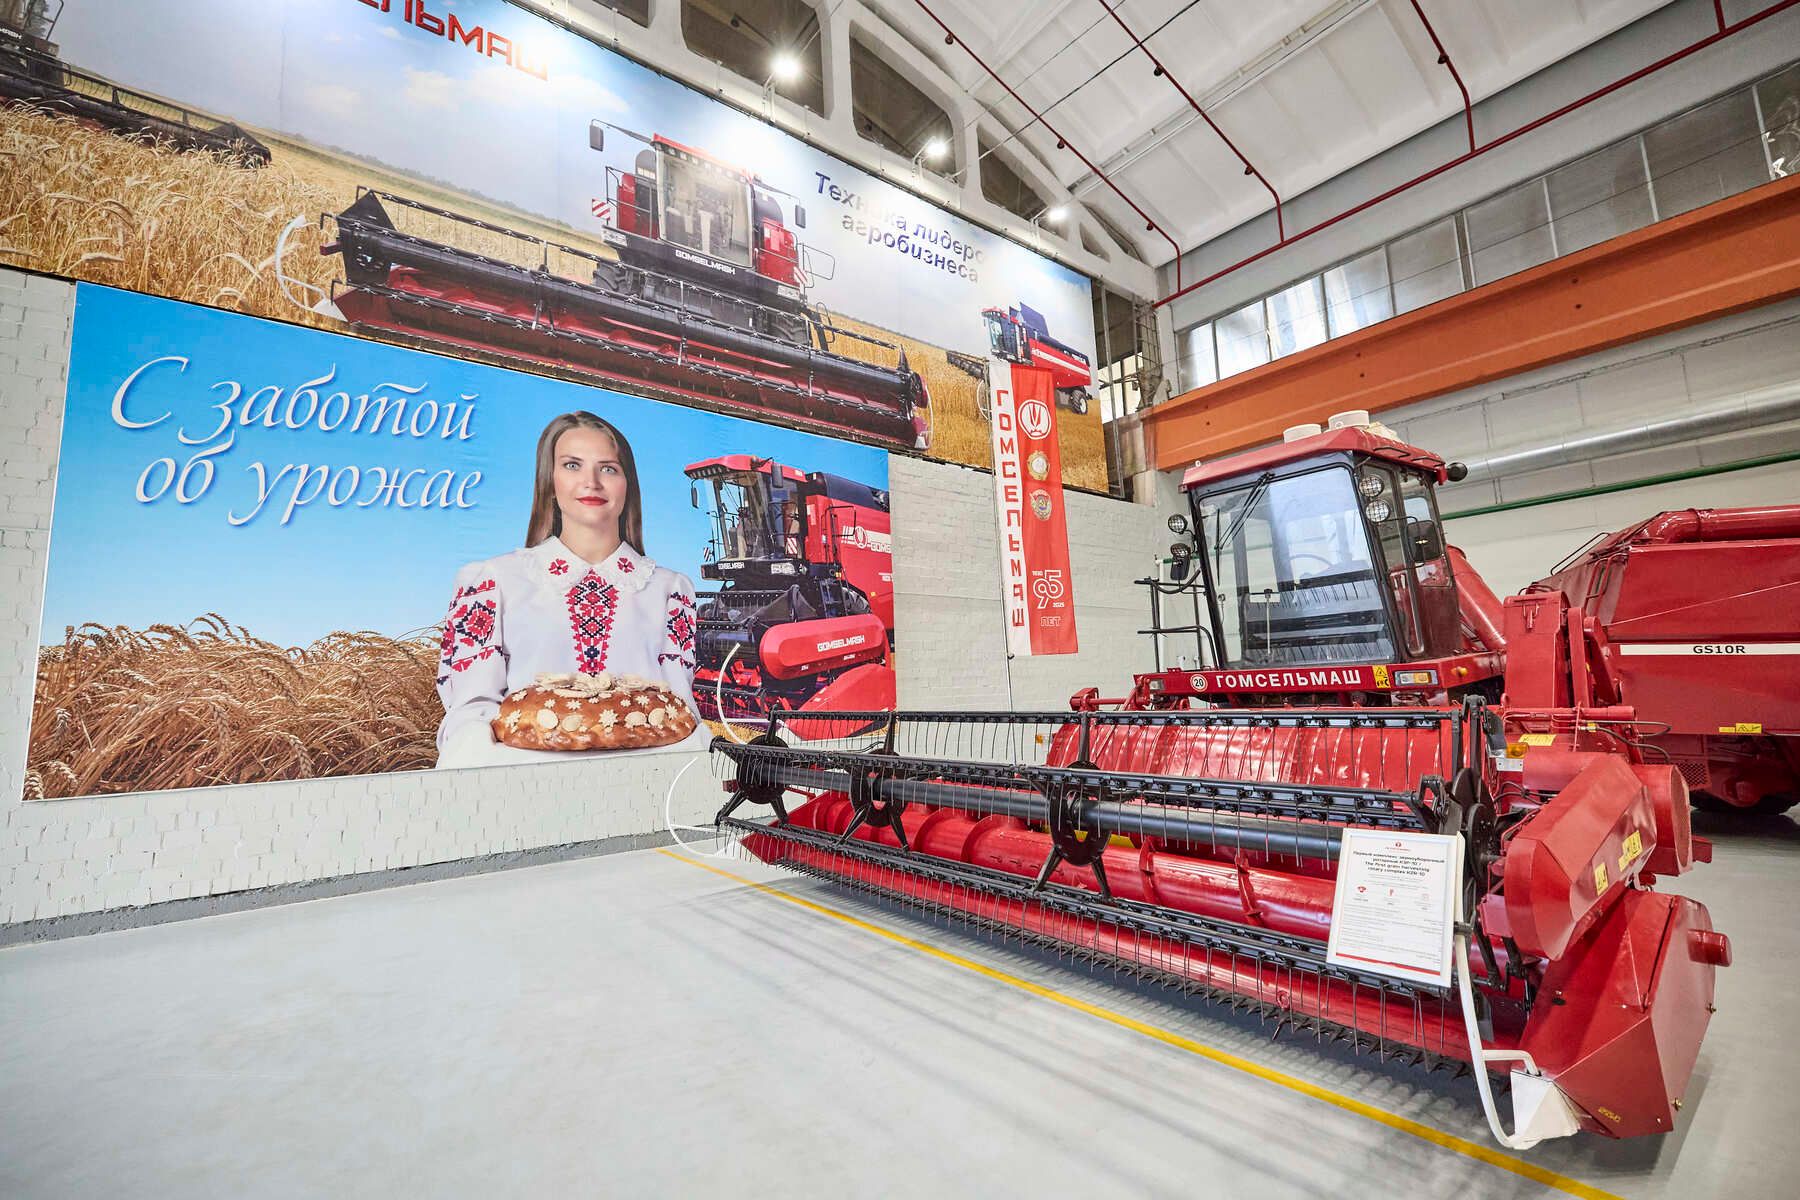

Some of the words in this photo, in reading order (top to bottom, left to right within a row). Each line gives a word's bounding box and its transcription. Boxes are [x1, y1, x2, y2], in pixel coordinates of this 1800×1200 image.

[815, 171, 907, 231] Технка
[913, 222, 986, 265] лидеро
[675, 249, 736, 276] GOMSELMASH
[842, 214, 979, 284] агробизнеса
[111, 355, 190, 430] С
[178, 362, 480, 445] заботой
[135, 429, 235, 504] об
[227, 461, 482, 528] урожае
[996, 389, 1025, 627] ГОМСЕЛЬМАШ
[817, 634, 865, 653] GOMSELMASH
[1692, 644, 1746, 654] GS10R
[1193, 677, 1204, 687] 20
[1215, 668, 1362, 690] ГОМСЕЛЬМАШ
